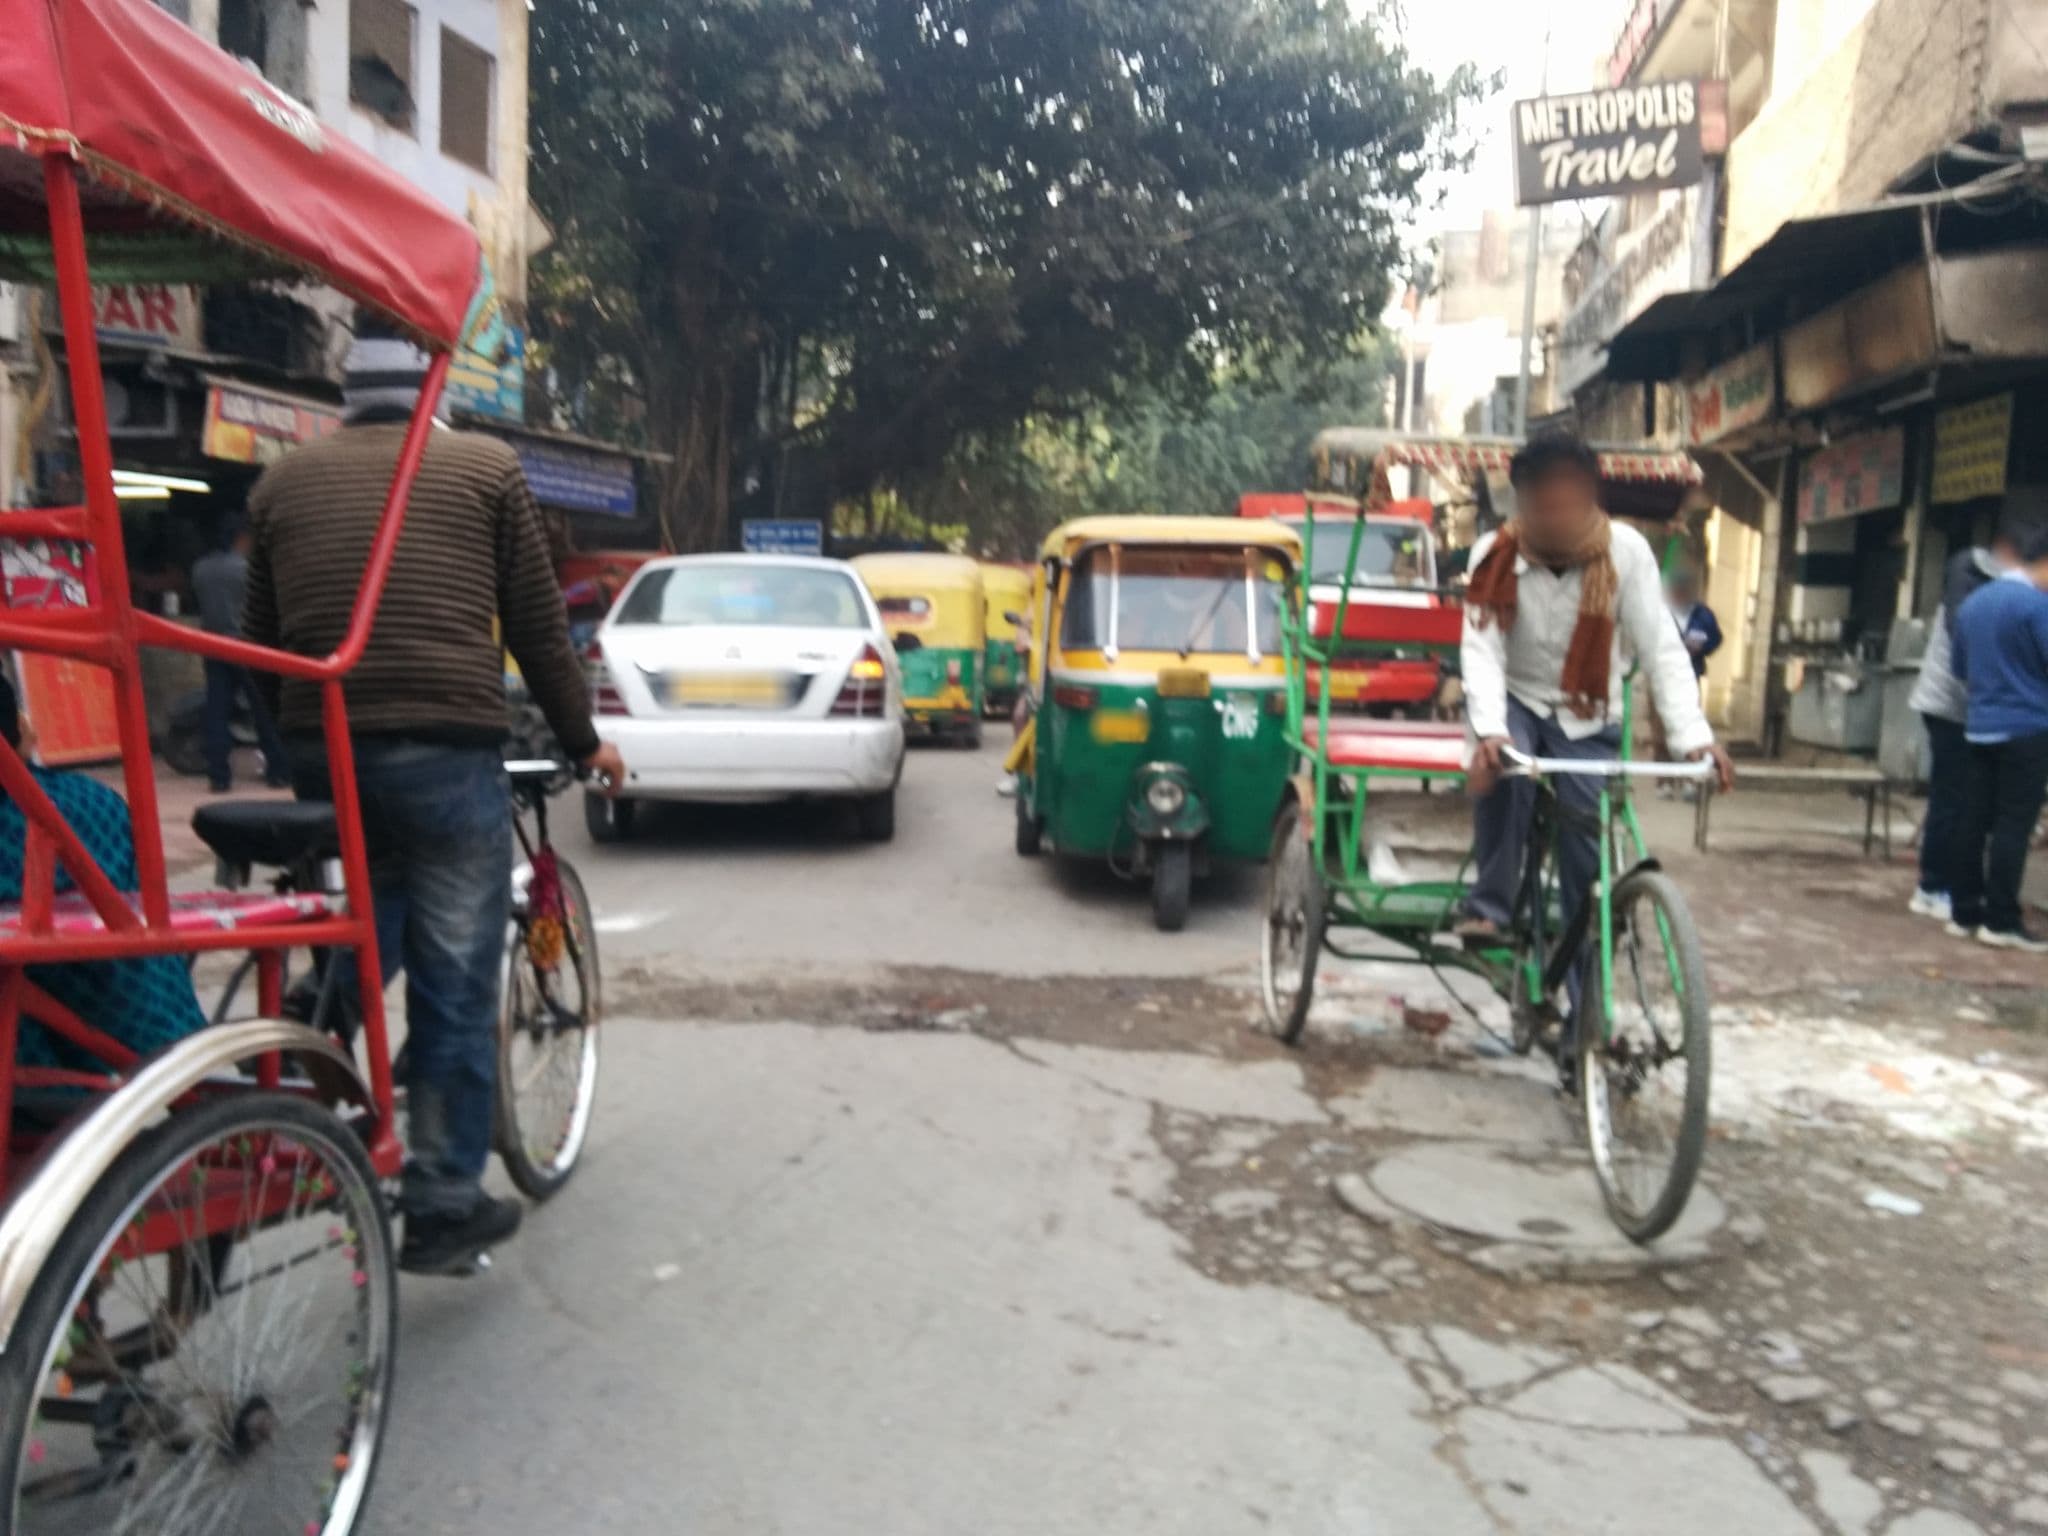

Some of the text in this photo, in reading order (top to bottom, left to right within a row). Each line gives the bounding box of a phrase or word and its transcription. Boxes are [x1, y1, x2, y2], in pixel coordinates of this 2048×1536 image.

[1519, 81, 1695, 145] METROPOLIS
[1540, 128, 1678, 190] Travel
[95, 284, 180, 335] AR
